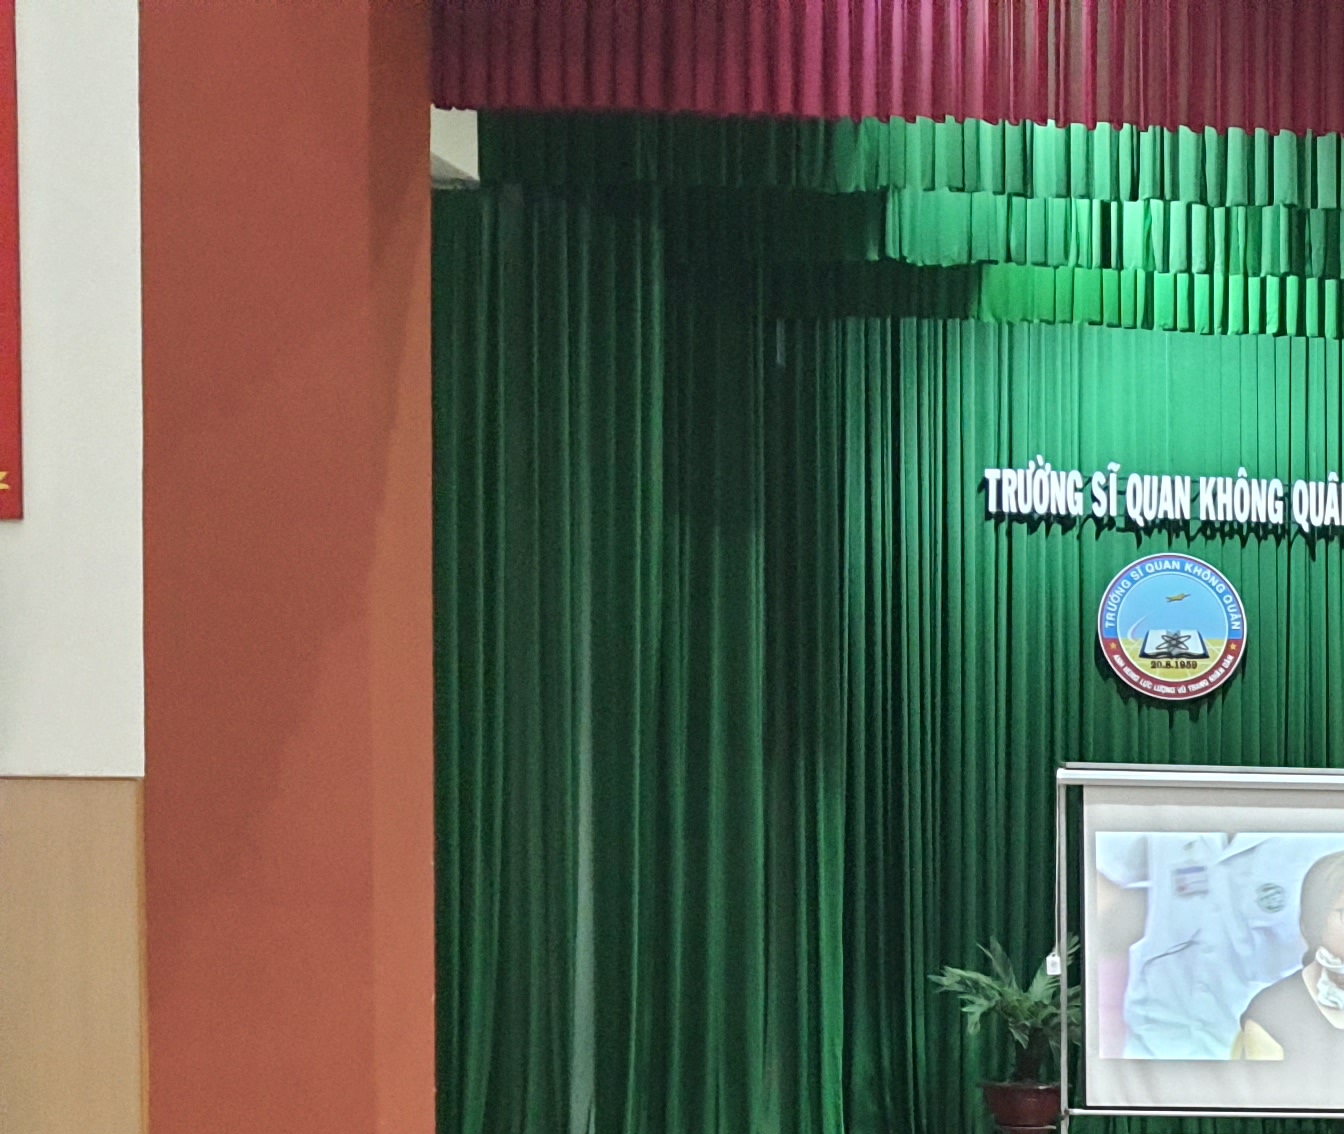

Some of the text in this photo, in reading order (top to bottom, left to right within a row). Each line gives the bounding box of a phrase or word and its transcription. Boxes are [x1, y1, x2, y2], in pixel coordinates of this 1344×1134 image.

[985, 454, 1083, 516] TRƯỜNG
[1091, 462, 1121, 518] SĨ
[1126, 472, 1191, 527] QUAN
[1199, 467, 1284, 524] KHÔNG
[1145, 560, 1181, 573] QUAN
[1184, 562, 1226, 594] KHÔNG
